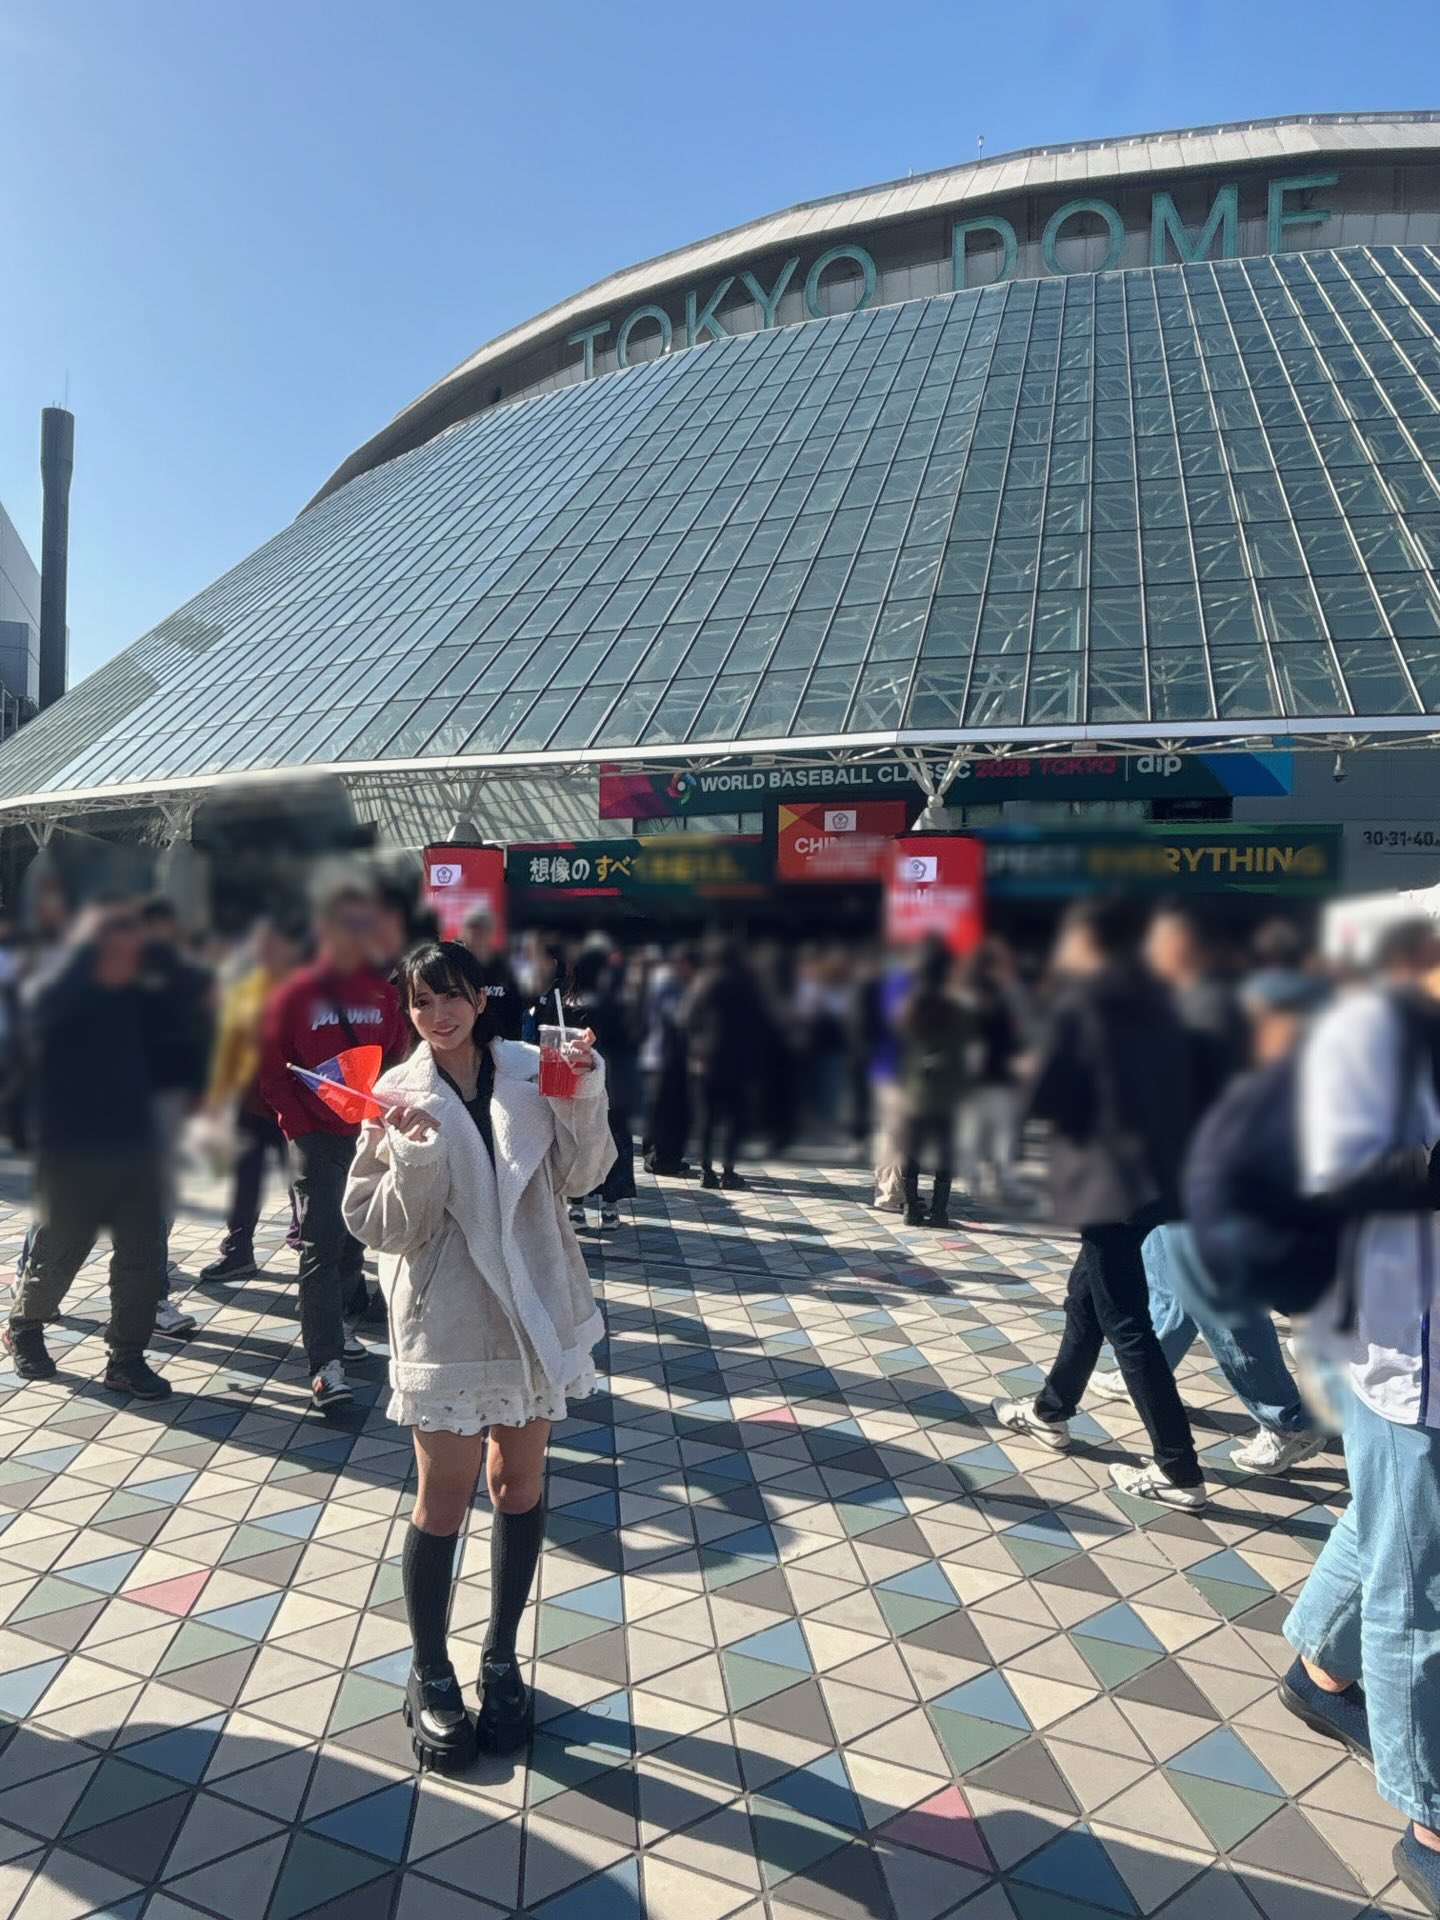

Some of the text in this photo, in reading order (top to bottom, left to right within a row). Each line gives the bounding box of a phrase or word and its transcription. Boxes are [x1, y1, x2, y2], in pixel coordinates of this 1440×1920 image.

[568, 173, 1339, 379] TOKYO DOME
[701, 773, 765, 793] WORLD
[769, 767, 873, 789] BASEBALL
[877, 761, 971, 783] CLSSC
[1039, 755, 1117, 776] TOKYO
[1136, 754, 1182, 777] dip
